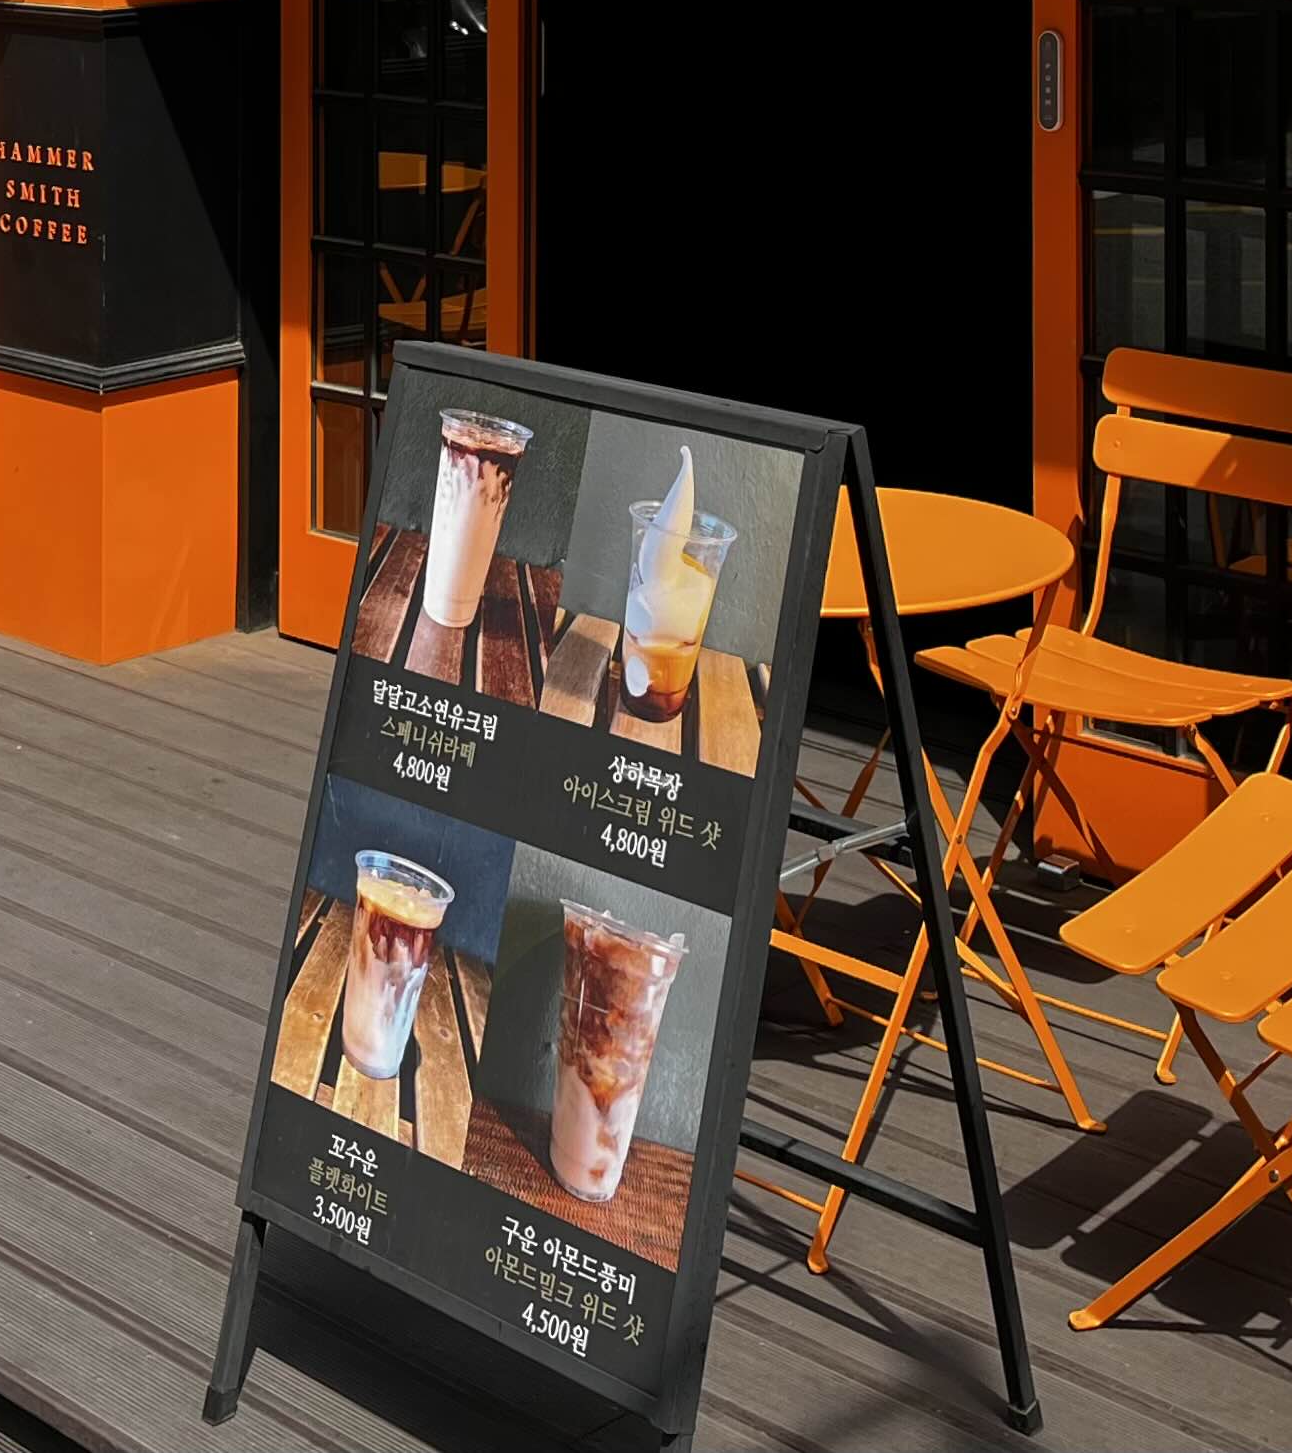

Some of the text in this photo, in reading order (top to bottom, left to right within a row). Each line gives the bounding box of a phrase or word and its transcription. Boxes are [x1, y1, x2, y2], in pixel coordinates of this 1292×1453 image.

[6, 179, 81, 208] SMITH
[0, 213, 88, 244] COFFEE
[373, 679, 498, 741] 달달고소연유크림
[380, 716, 476, 768] 스페니쉬라떼
[393, 751, 451, 792] 4,800원
[608, 755, 683, 801] 상하목장
[563, 775, 721, 850] 아이스크림 위드 샷
[600, 823, 667, 868] 4,800원
[328, 1134, 379, 1178] 꼬수운
[313, 1195, 372, 1245] 3,500원
[502, 1216, 637, 1305] 구운 아몬드풍미
[485, 1246, 645, 1346] 아몬드밀크 위드 샷
[522, 1302, 589, 1357] 4,500원
